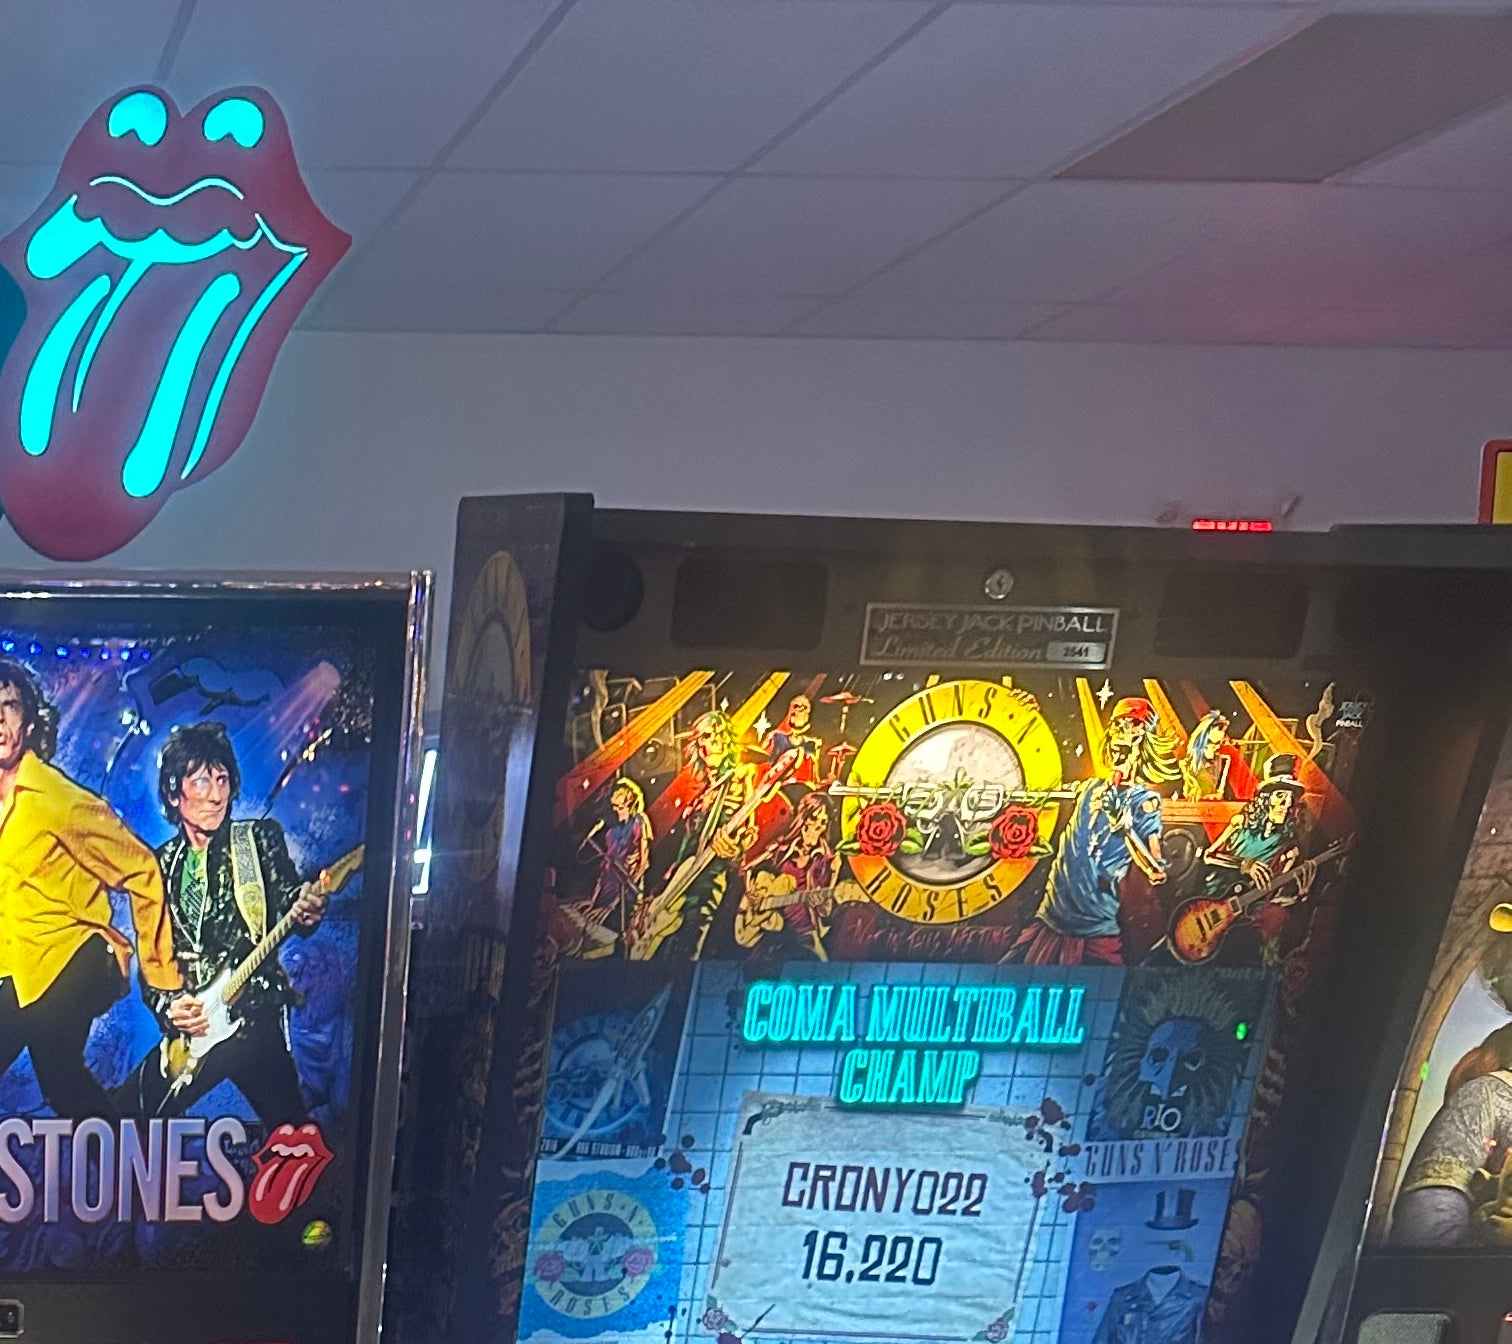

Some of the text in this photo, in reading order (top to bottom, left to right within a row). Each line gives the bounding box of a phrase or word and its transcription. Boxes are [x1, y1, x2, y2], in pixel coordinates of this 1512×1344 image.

[878, 611, 1108, 634] JERSEY JACK PINBALL
[968, 636, 1041, 660] Edition
[889, 684, 997, 743] GUNS
[865, 866, 1003, 922] ROSES
[743, 982, 1087, 1044] COMA MULTIBALL
[839, 1049, 980, 1104] CHAMP
[1141, 1104, 1182, 1131] RIO
[1085, 1142, 1144, 1177] GUNS
[802, 1230, 943, 1286] 16.220
[548, 1286, 631, 1317] ROSES
